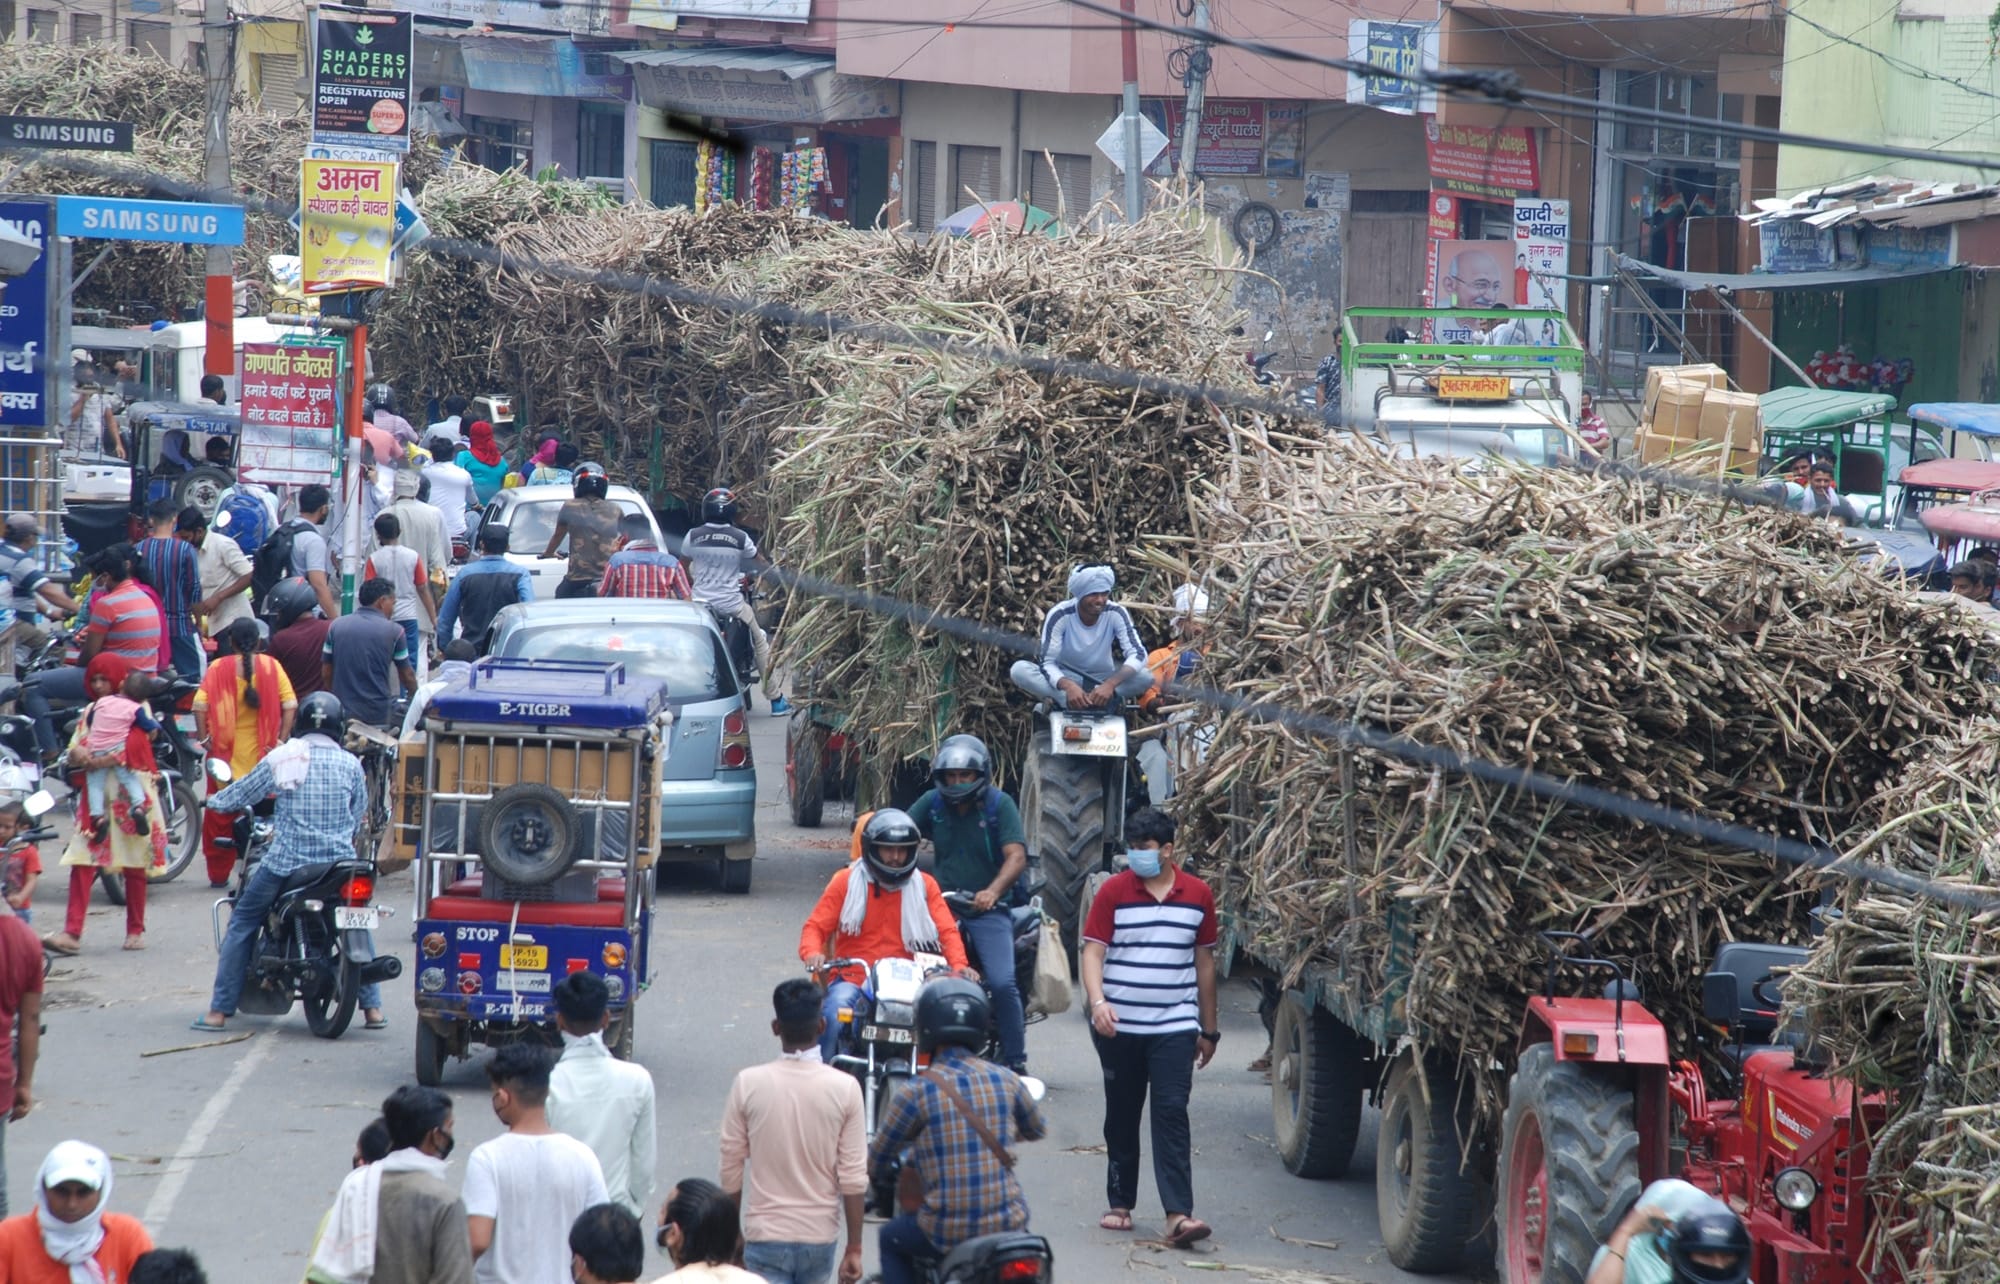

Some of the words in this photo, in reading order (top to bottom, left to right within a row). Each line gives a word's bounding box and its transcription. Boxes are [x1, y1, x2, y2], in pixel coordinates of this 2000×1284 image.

[323, 49, 405, 66] SHAPERS
[321, 62, 406, 79] ACADEMY
[320, 86, 406, 99] REGISTRATIONS
[320, 96, 348, 105] OPEN
[13, 123, 116, 144] SAMSUNG
[1231, 119, 1261, 137] पार्लर
[317, 167, 382, 192] अमन
[308, 194, 338, 215] स्पेशल
[363, 200, 389, 216] चावल
[1516, 202, 1552, 222] खादी
[83, 207, 218, 236] SAMSUNG
[1531, 223, 1567, 238] भवन
[1542, 260, 1552, 268] पर
[244, 348, 290, 376] गणपति
[244, 380, 268, 398] हमारे
[270, 381, 290, 399] यहाँ
[290, 383, 307, 400] फटे
[308, 384, 332, 406] पुराने
[248, 403, 266, 421] नोट
[267, 406, 290, 423] बदले
[292, 406, 311, 424] जाते
[499, 702, 572, 717] E-TIGER
[457, 927, 499, 941] STOP
